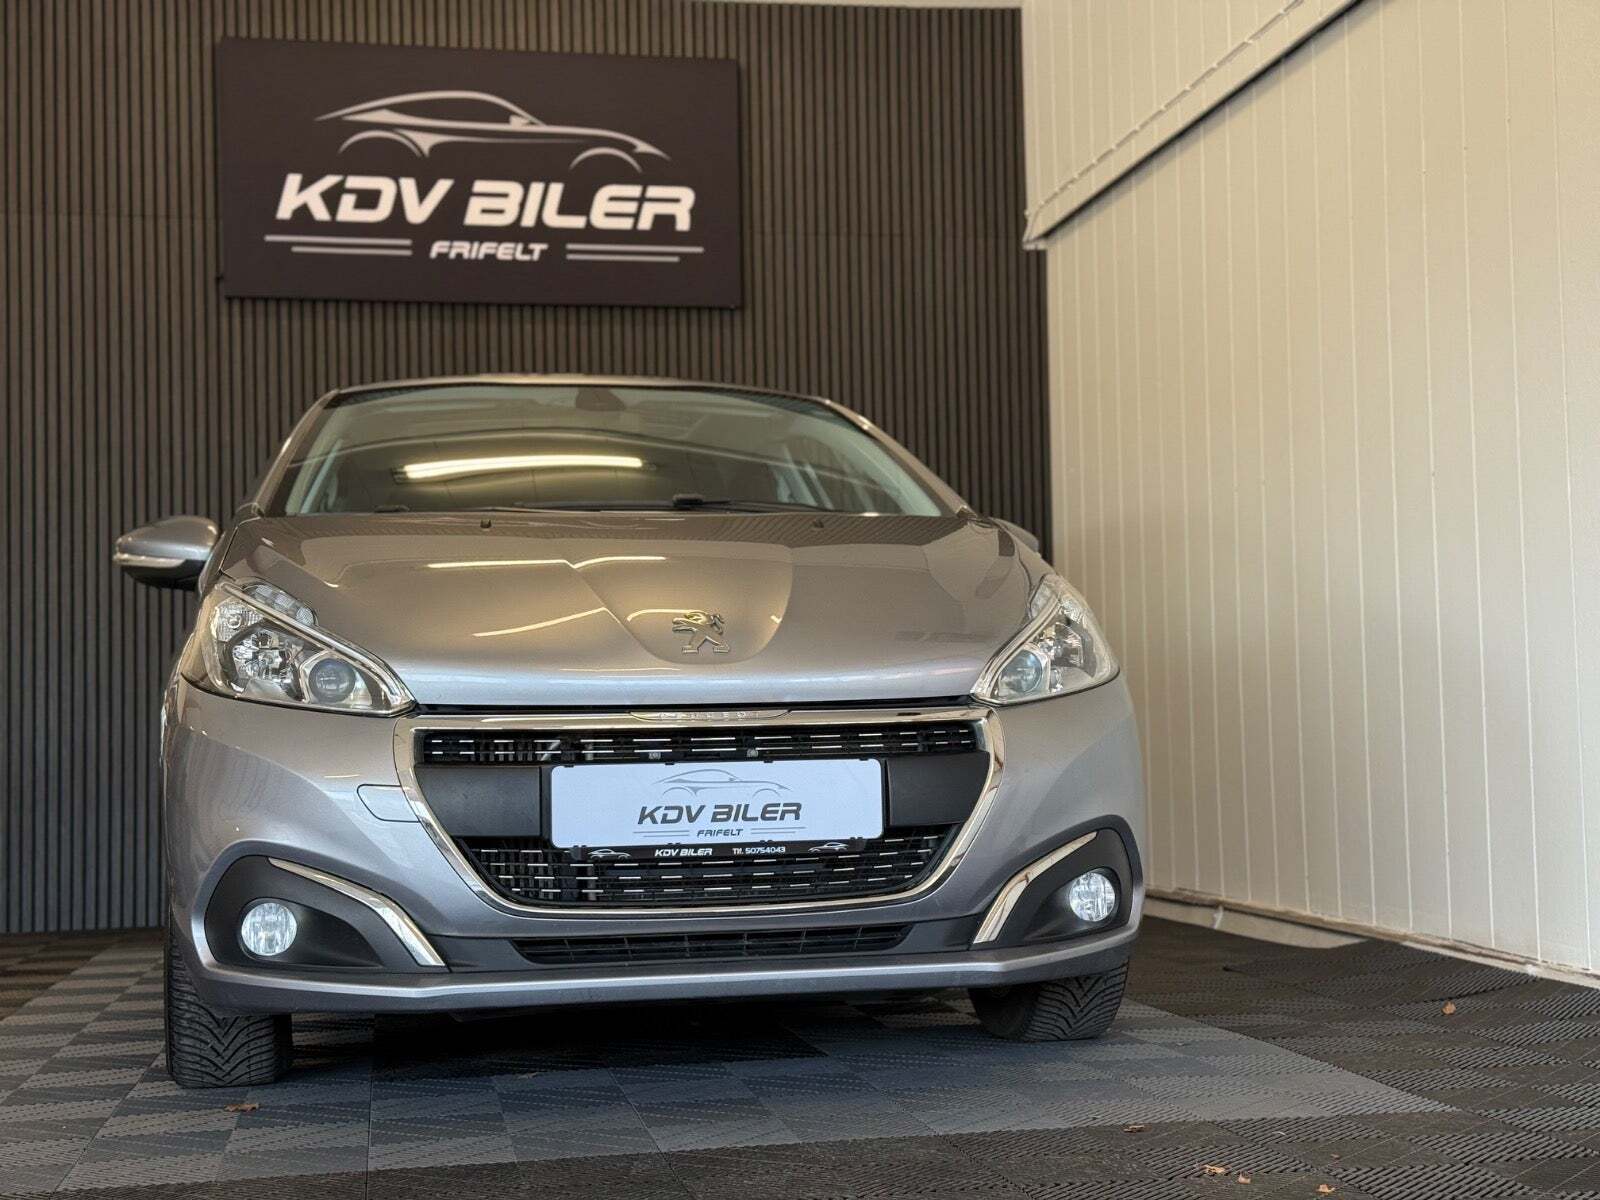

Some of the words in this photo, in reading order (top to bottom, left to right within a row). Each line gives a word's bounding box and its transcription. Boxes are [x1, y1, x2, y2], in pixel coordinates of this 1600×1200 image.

[276, 173, 454, 226] KDV
[464, 180, 695, 231] BILER
[429, 240, 549, 261] FRIFELT
[637, 804, 706, 825] KDV
[711, 802, 802, 822] BILER
[697, 828, 744, 837] FRIFELT
[654, 849, 679, 857] KDV
[680, 848, 713, 856] BILER
